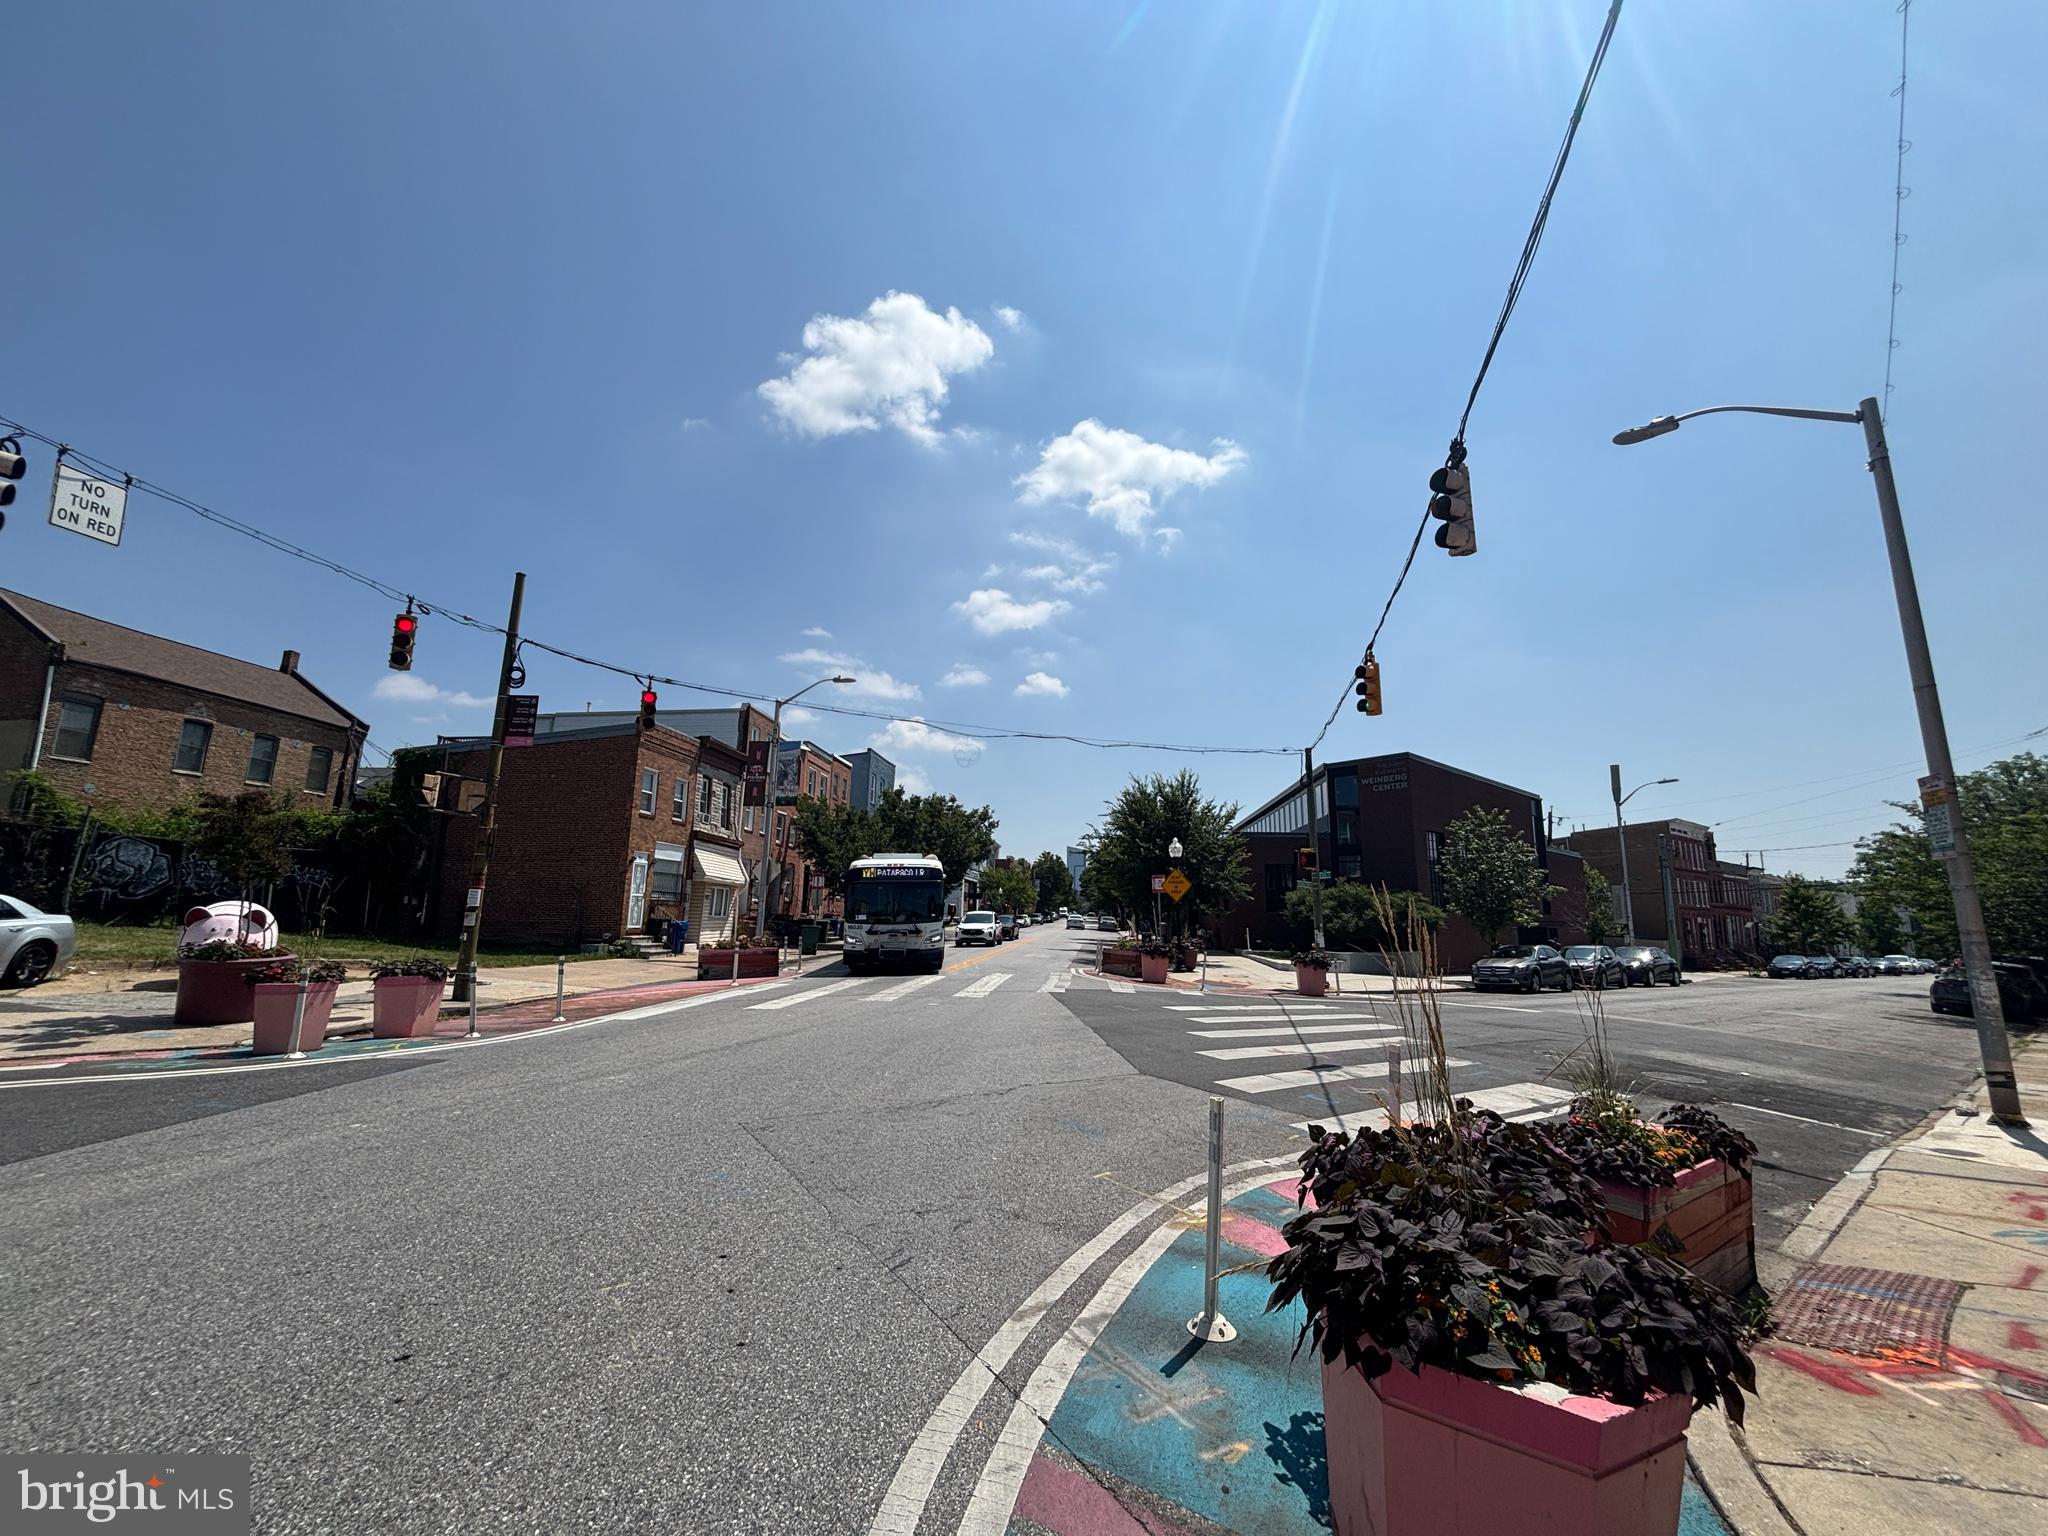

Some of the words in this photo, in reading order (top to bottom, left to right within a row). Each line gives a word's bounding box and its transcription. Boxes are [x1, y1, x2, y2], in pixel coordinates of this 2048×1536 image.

[81, 480, 105, 498] NO
[70, 493, 110, 518] TURN
[57, 508, 79, 525] ON
[87, 518, 116, 537] RED
[1361, 774, 1407, 784] WEINBERG
[1373, 782, 1408, 791] CENTER
